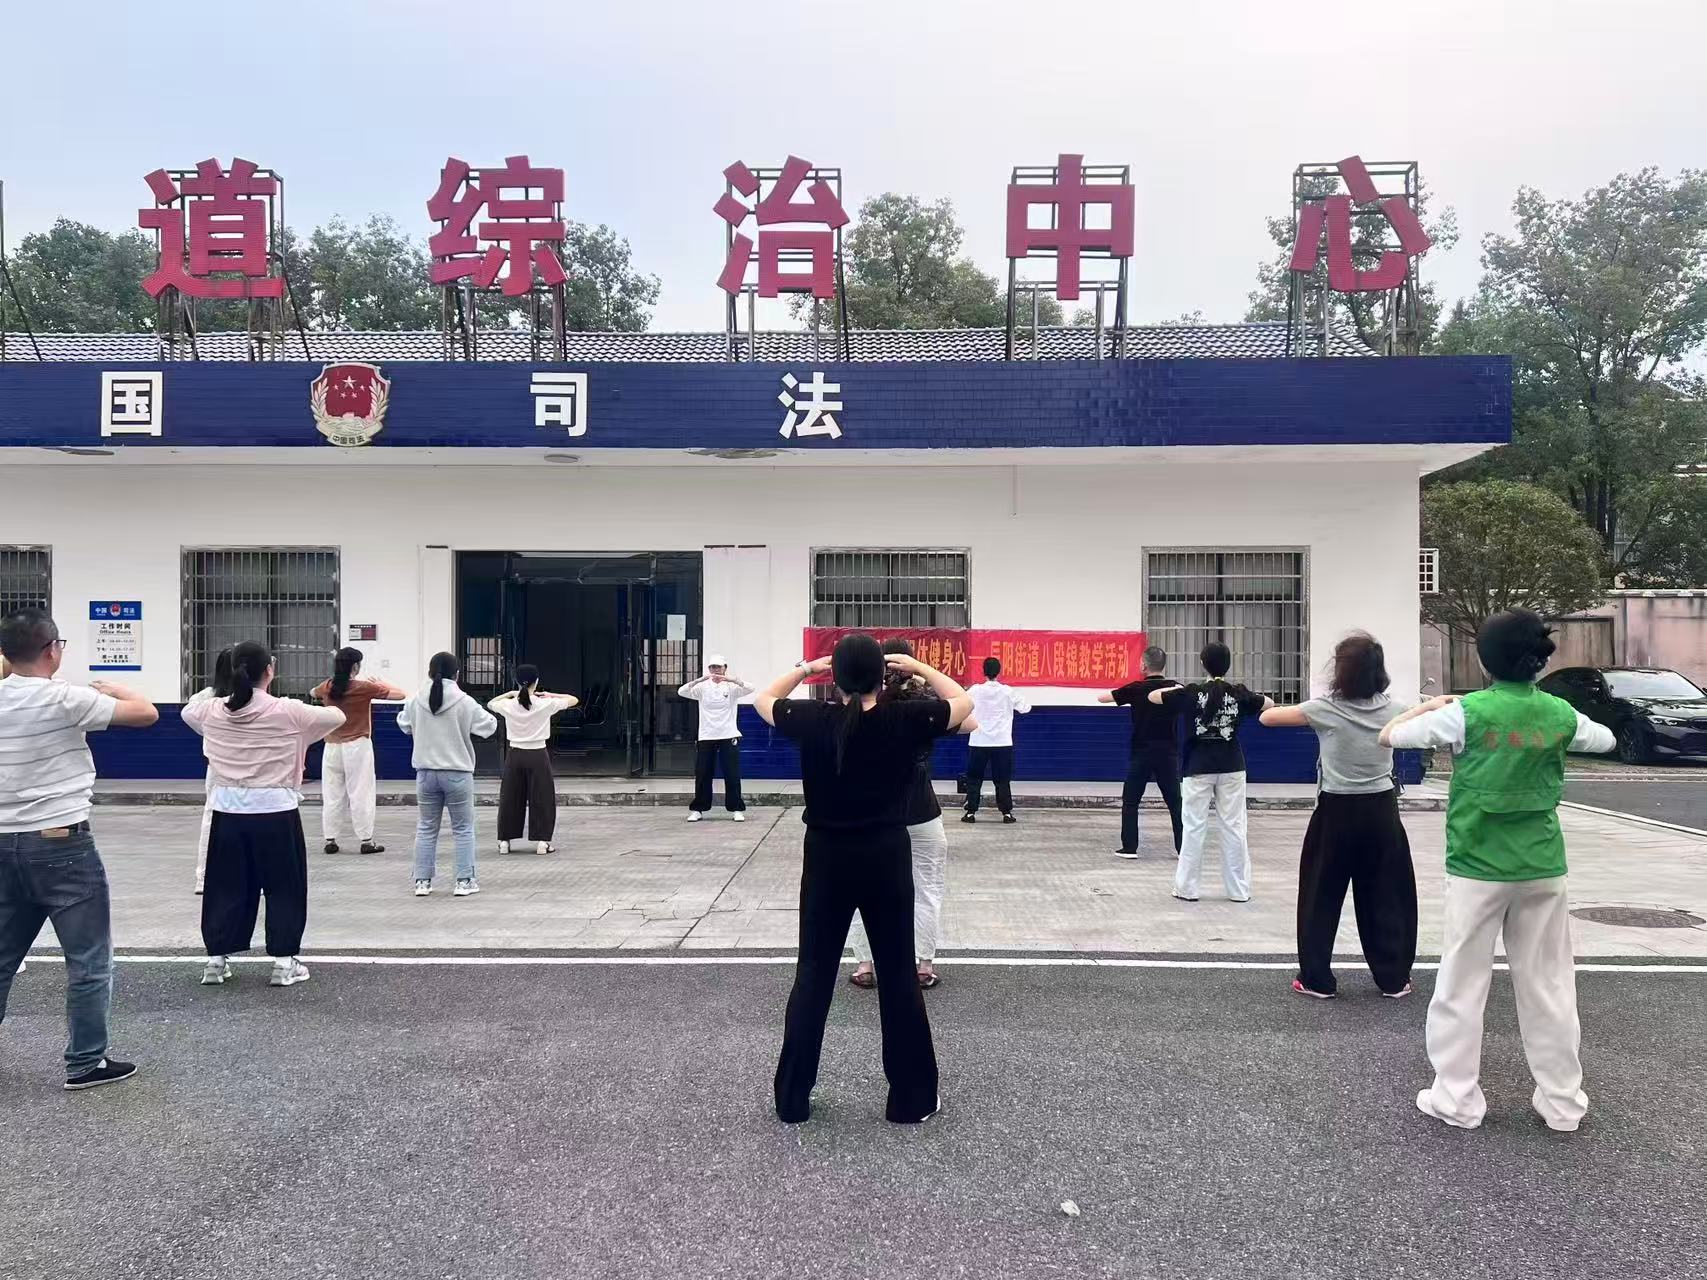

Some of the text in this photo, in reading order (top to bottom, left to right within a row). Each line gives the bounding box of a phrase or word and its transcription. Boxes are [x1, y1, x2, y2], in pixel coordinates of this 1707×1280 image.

[138, 154, 1430, 300] 道综治中心
[101, 372, 163, 437] 国
